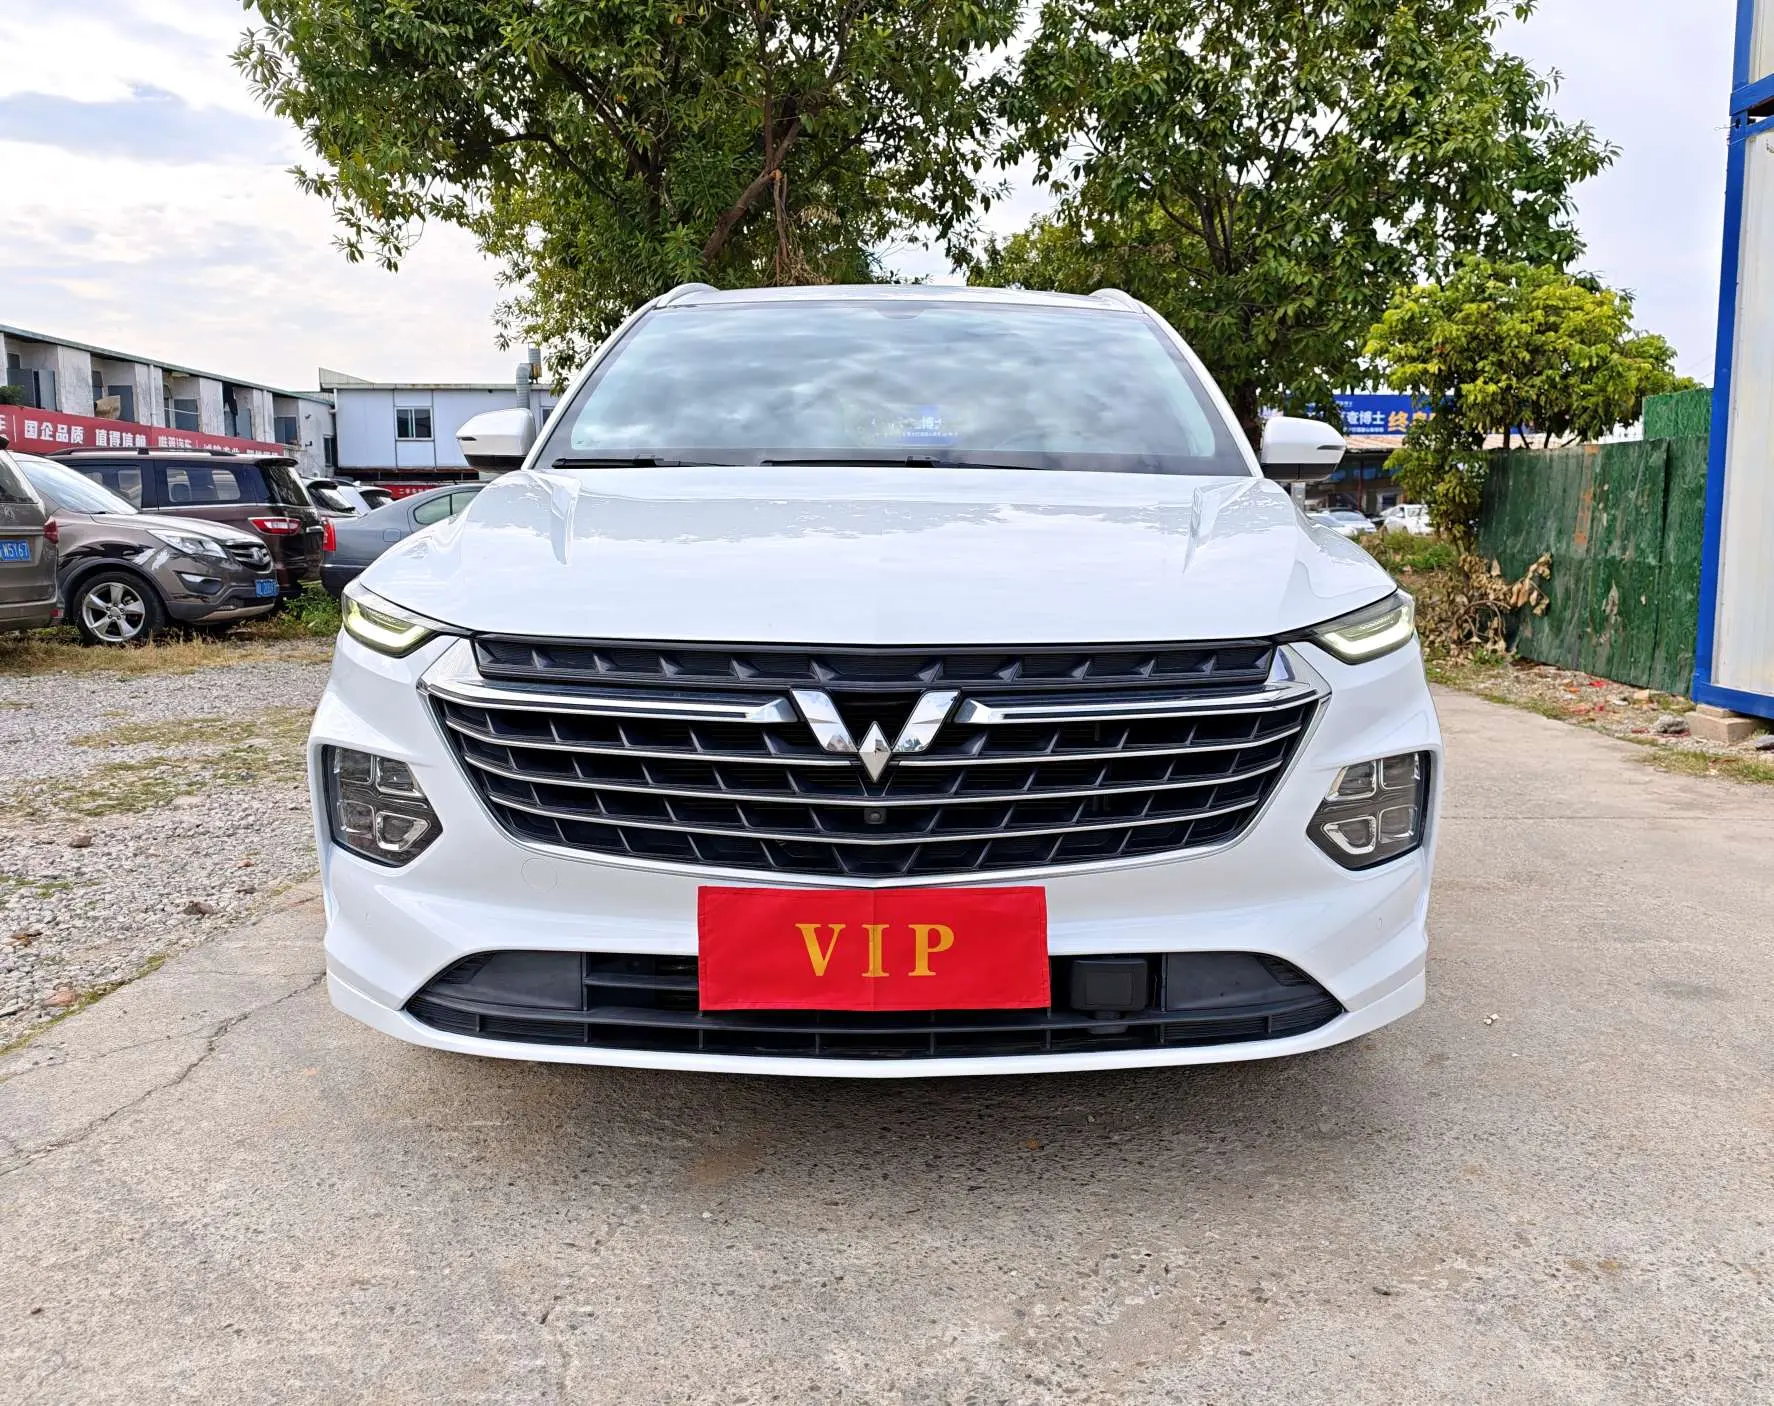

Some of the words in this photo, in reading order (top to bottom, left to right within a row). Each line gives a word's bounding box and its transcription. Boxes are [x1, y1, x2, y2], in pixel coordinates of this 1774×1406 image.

[25, 420, 84, 445] 国企品质
[795, 923, 955, 977] VIP
